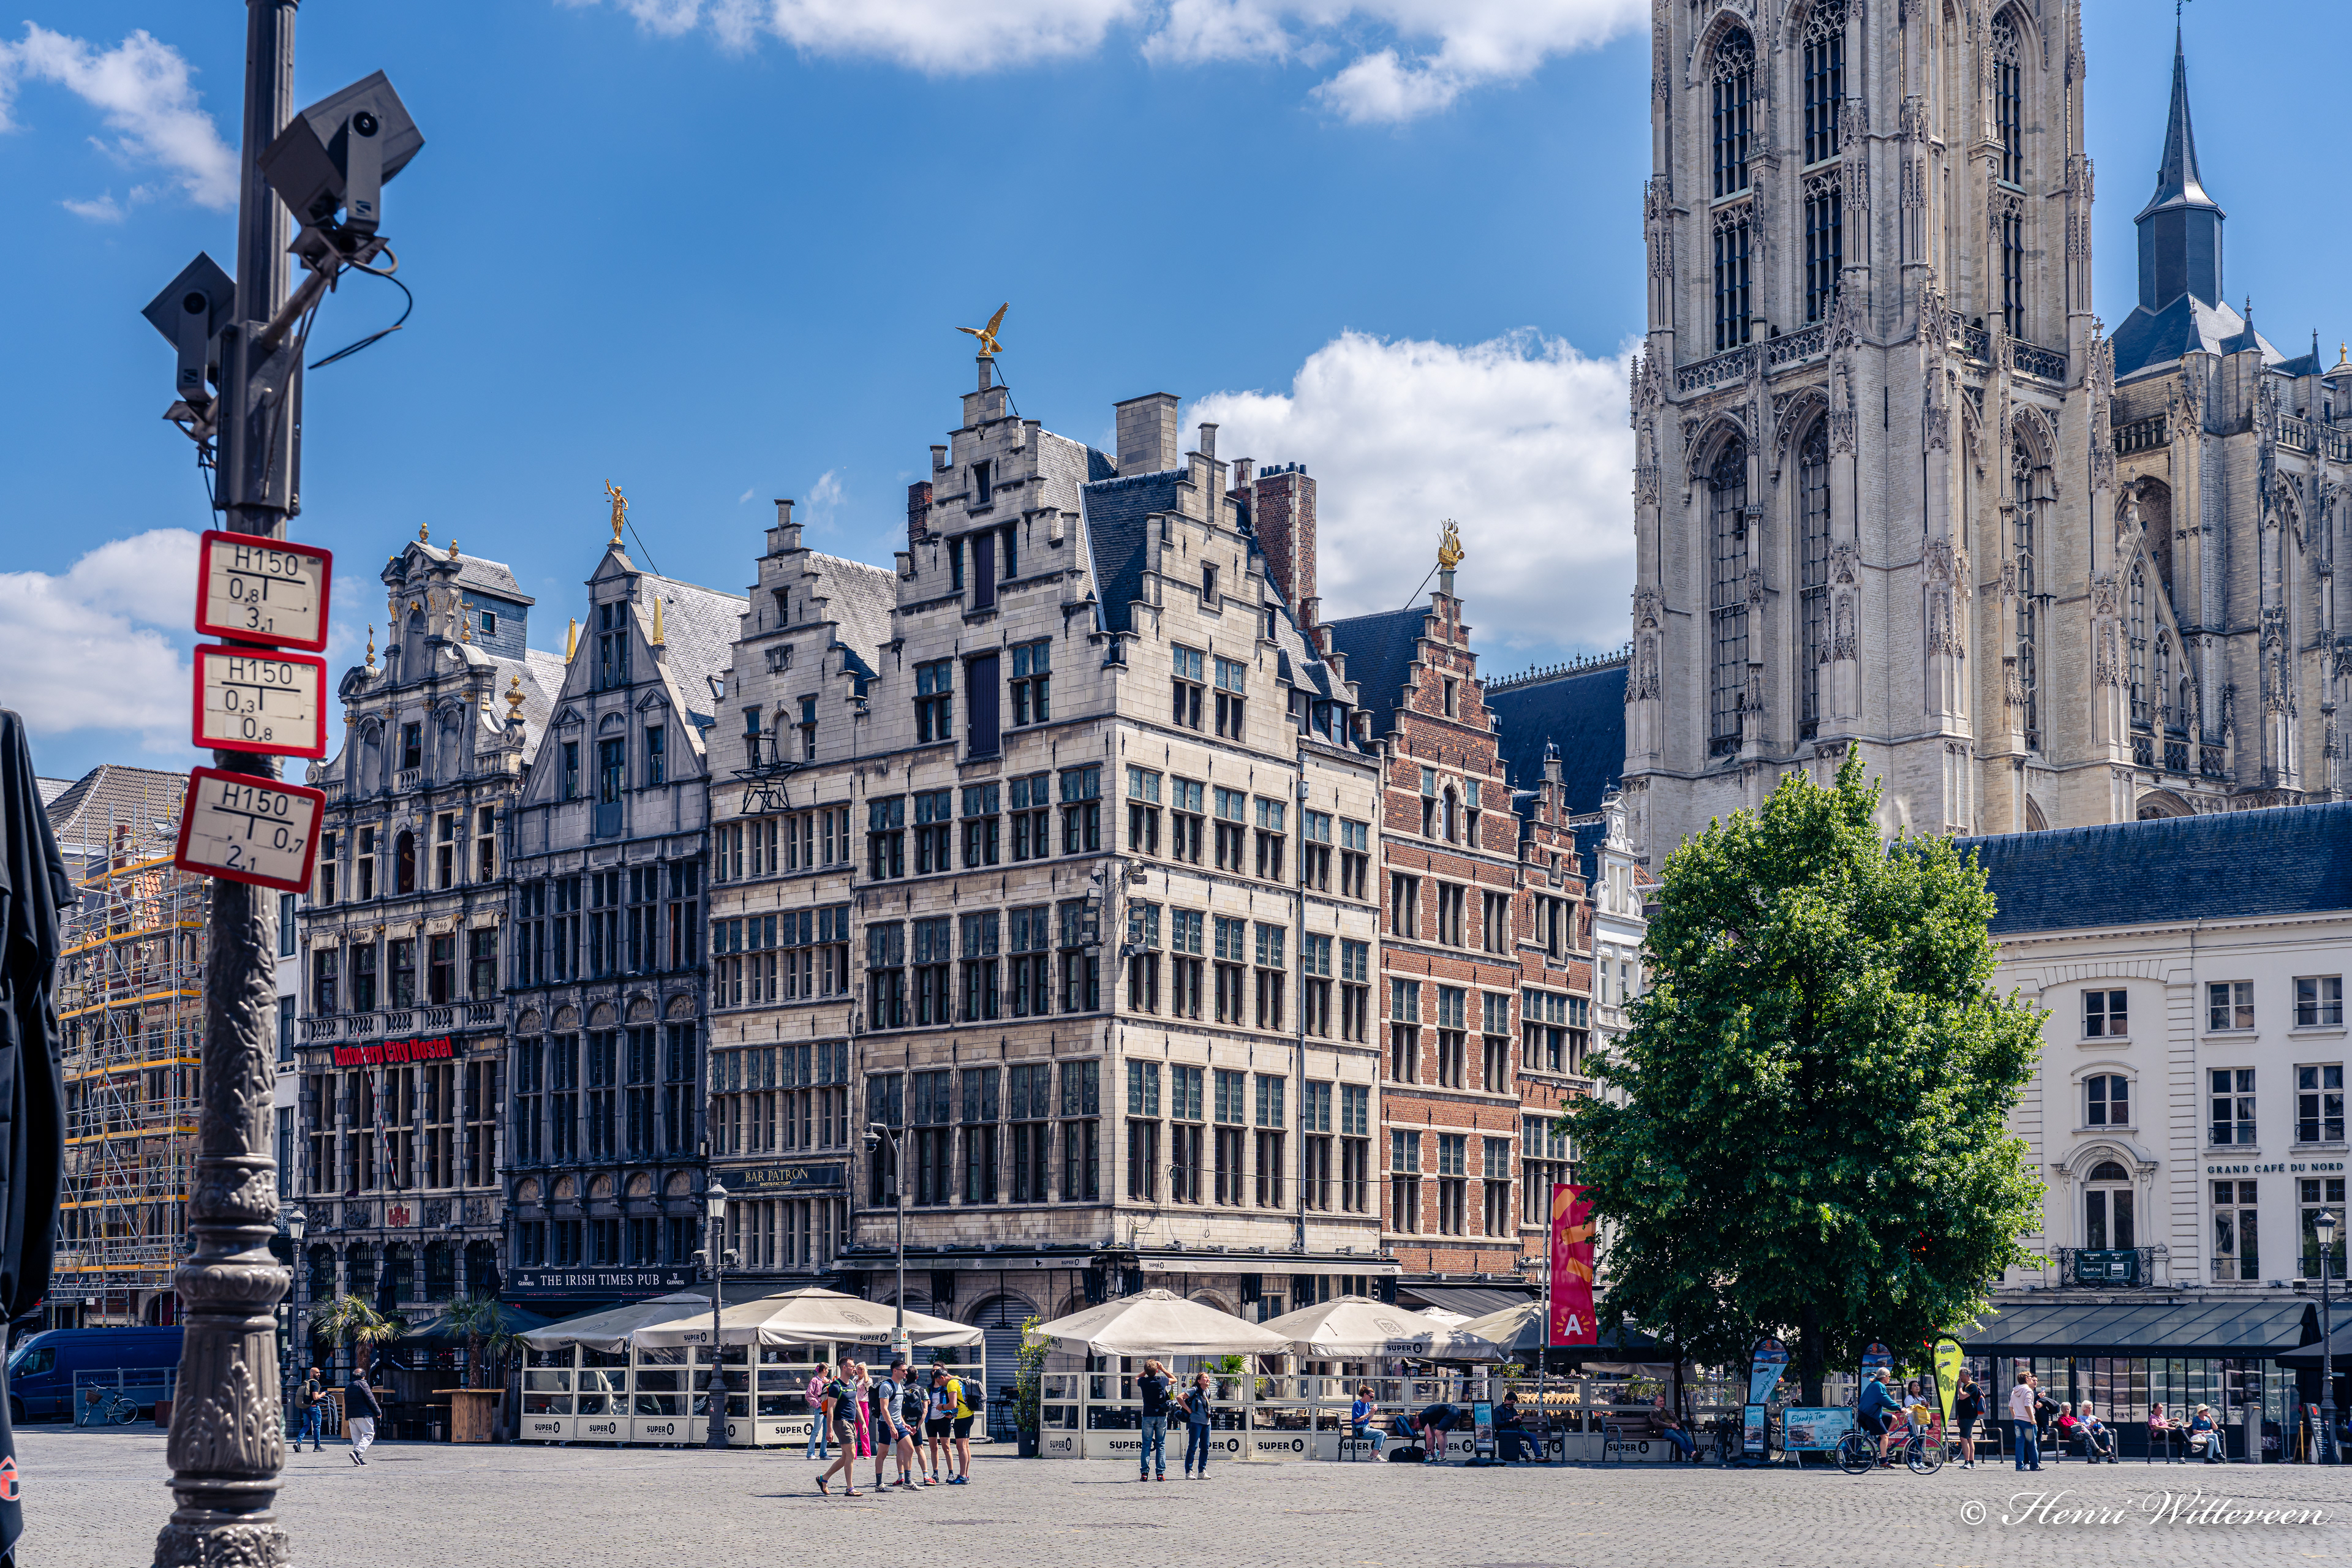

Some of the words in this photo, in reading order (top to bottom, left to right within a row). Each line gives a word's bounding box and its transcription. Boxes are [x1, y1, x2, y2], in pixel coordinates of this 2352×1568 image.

[235, 546, 298, 576] H150
[230, 578, 259, 603] 0,8
[246, 607, 273, 631] 3,1
[230, 657, 292, 684] H150
[225, 690, 255, 714] 0,3
[243, 718, 273, 742] 0,8
[222, 783, 288, 816] H150
[274, 827, 304, 853] 0,7
[226, 845, 257, 871] 2,1
[334, 1046, 385, 1066] Antwerp
[384, 1041, 411, 1063] City
[409, 1036, 454, 1060] Hostel
[745, 1170, 765, 1182] BAR
[768, 1168, 808, 1181] PATRON
[2255, 1163, 2285, 1172] CAFÉ
[540, 1275, 562, 1286] THE
[566, 1275, 595, 1285] IRISH
[599, 1274, 633, 1285] TIMES
[638, 1274, 660, 1285] PUB
[1564, 1314, 1583, 1336] A
